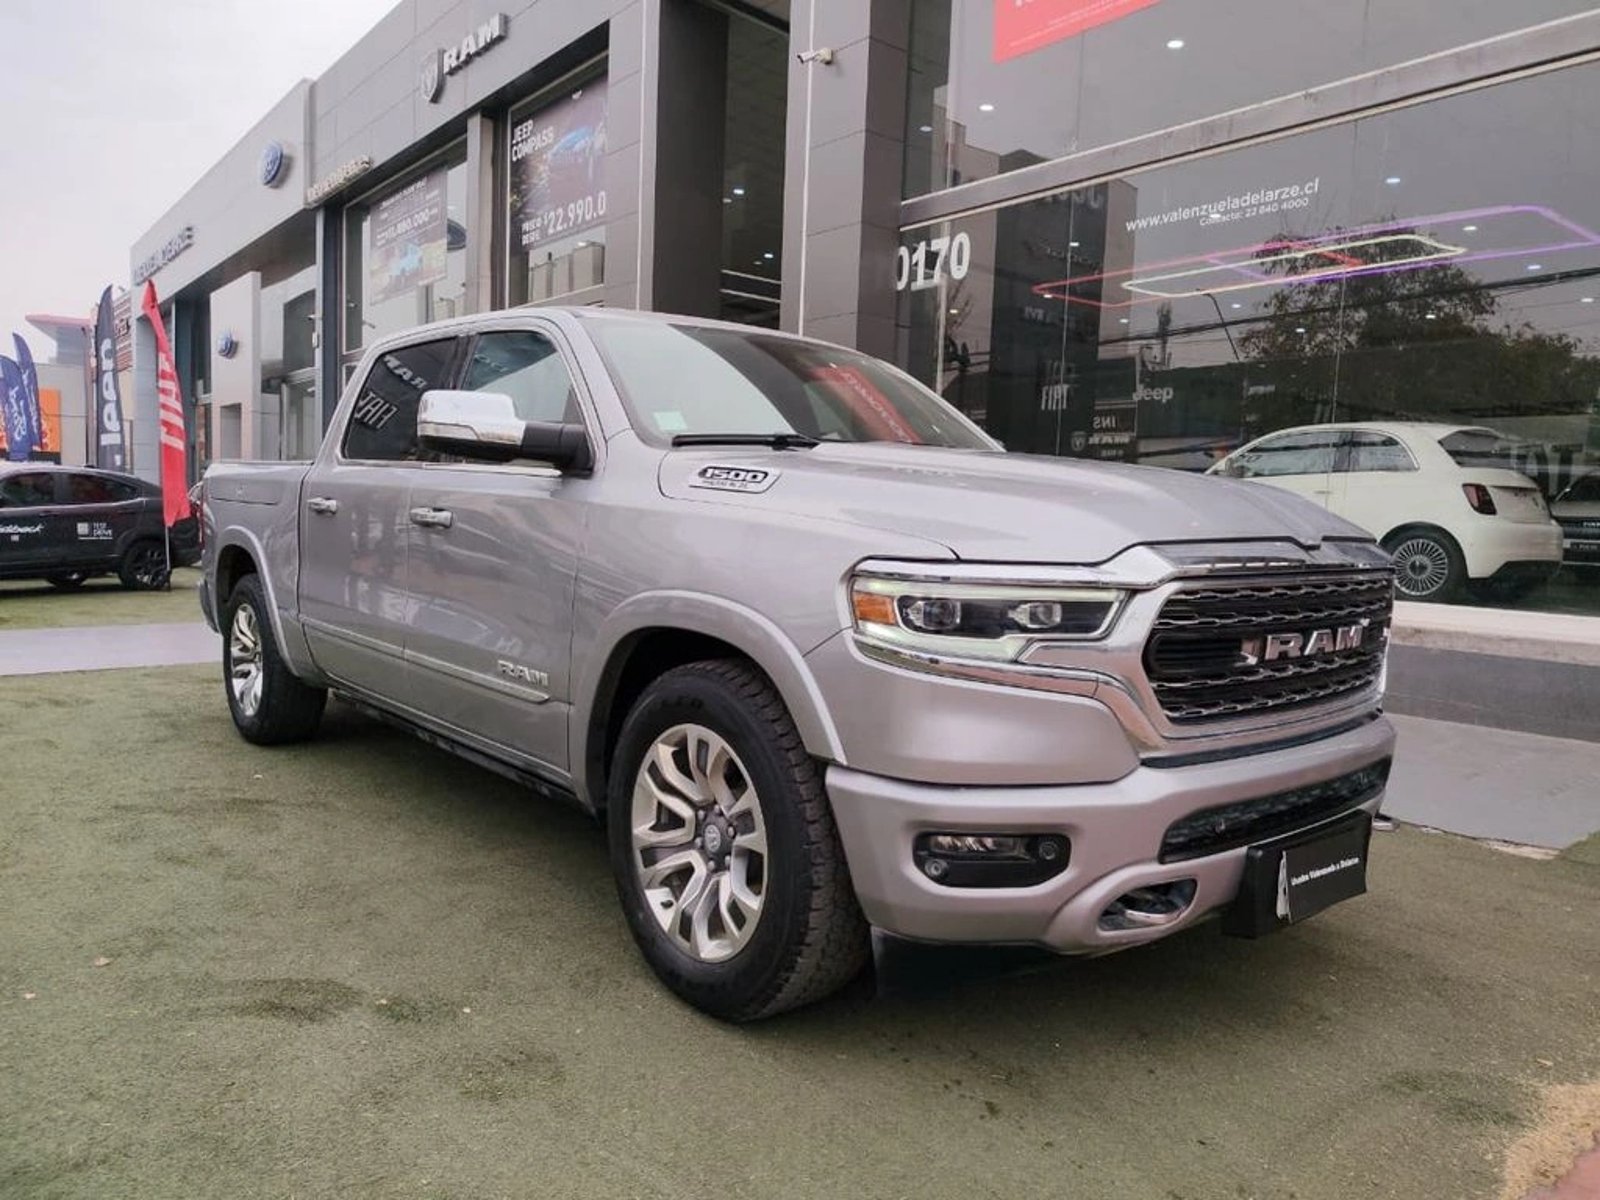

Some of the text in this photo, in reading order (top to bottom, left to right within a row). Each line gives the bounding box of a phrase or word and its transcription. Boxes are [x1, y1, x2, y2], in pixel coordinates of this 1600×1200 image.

[443, 13, 508, 76] RAM
[512, 119, 534, 144] JEEP
[512, 126, 554, 162] COMPASS
[1126, 177, 1320, 231] www.valenzueladelarze.cl
[1200, 210, 1244, 226] Coacto:
[1132, 383, 1174, 403] Jeep
[701, 467, 767, 483] 1500
[1265, 624, 1364, 661] RAM
[497, 660, 549, 687] RAM
